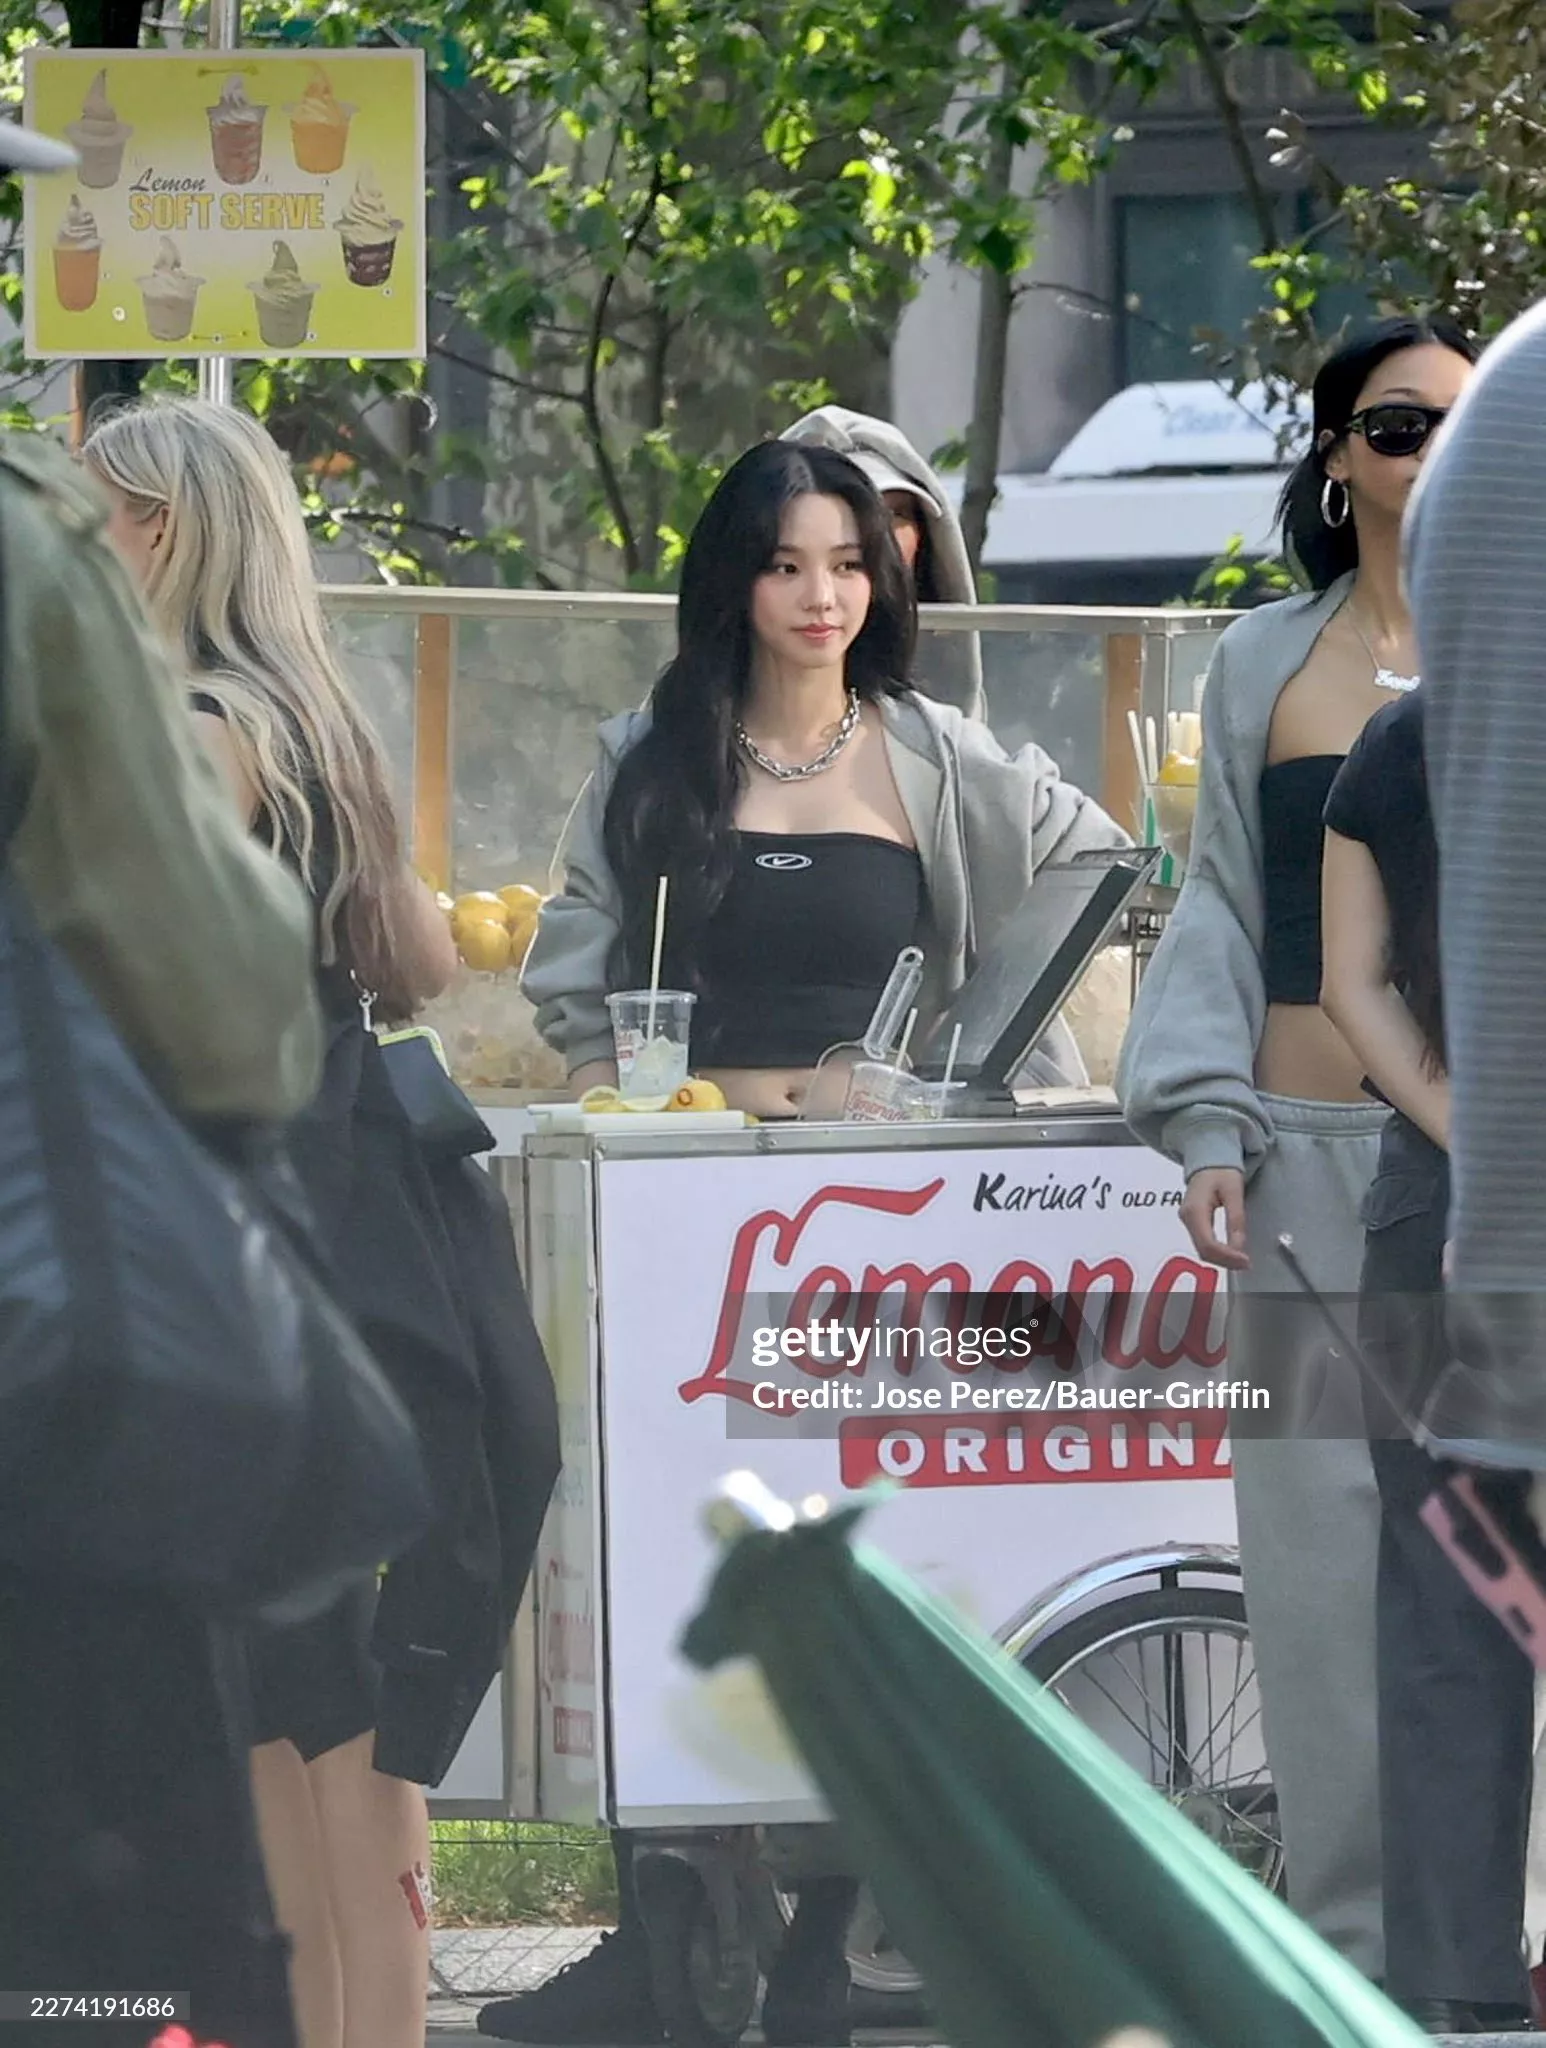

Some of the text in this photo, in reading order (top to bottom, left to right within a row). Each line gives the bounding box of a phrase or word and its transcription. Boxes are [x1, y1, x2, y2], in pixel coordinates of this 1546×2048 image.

[129, 167, 206, 192] Lemon
[129, 193, 325, 230] SOFT SERVE
[1122, 1191, 1156, 1208] OLD
[1160, 1190, 1184, 1207] FA
[678, 1177, 1228, 1417] Lemona
